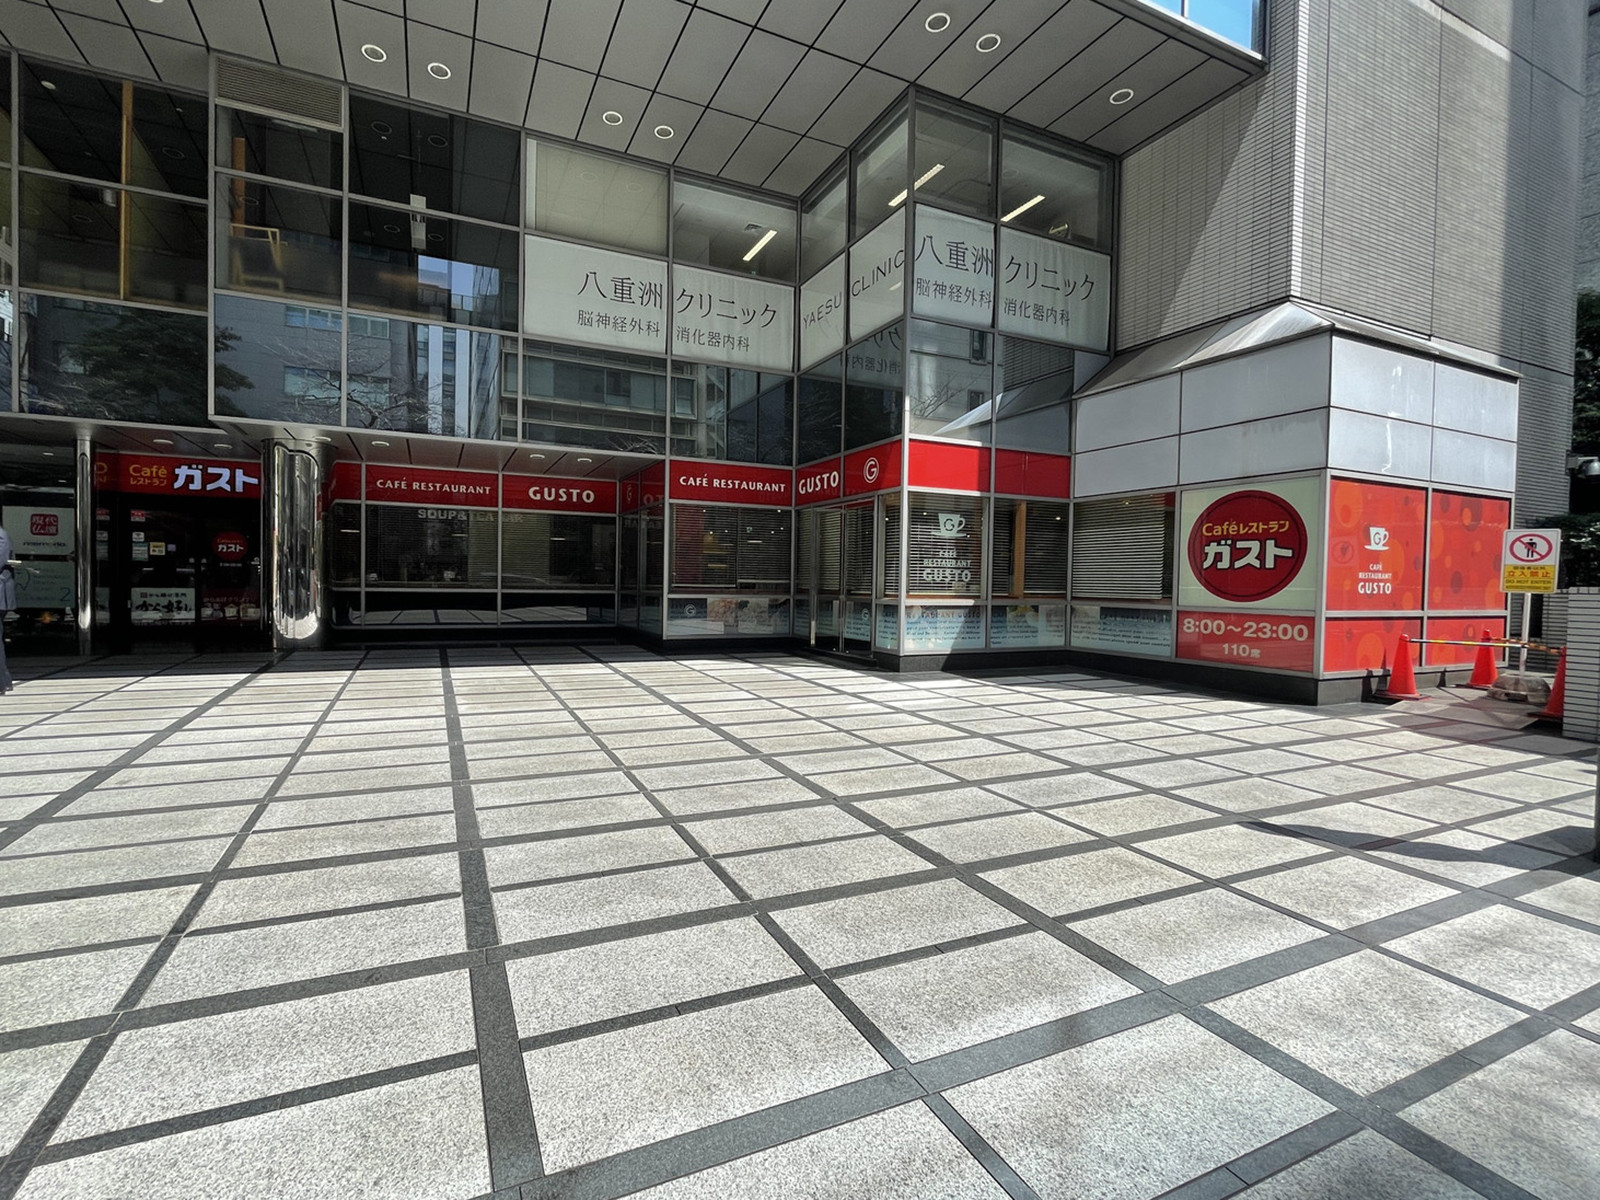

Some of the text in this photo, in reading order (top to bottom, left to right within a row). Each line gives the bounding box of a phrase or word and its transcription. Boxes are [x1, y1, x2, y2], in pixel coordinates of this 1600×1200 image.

[915, 234, 1095, 300] 八重洲 クリニック
[803, 249, 905, 329] YAESU CLINIC
[578, 271, 777, 329] 八重洲 クリニック
[915, 277, 1070, 327] 脳神経外科 消化器内科
[577, 309, 750, 352] 脳神経外科 消化器内科
[129, 464, 168, 477] Café
[173, 464, 259, 493] ガスト
[130, 476, 168, 486] レストラン
[376, 476, 491, 495] CAFÉ RESTAURANT
[679, 473, 786, 493] CAFÉ RESTAURANT
[798, 470, 839, 494] GUSTO
[528, 486, 595, 504] GUSTO
[217, 544, 244, 552] ガスト
[1202, 539, 1293, 570] ガスト
[923, 568, 972, 582] GUSTO
[1358, 582, 1392, 595] GUSTO
[1222, 643, 1261, 659] 110席
